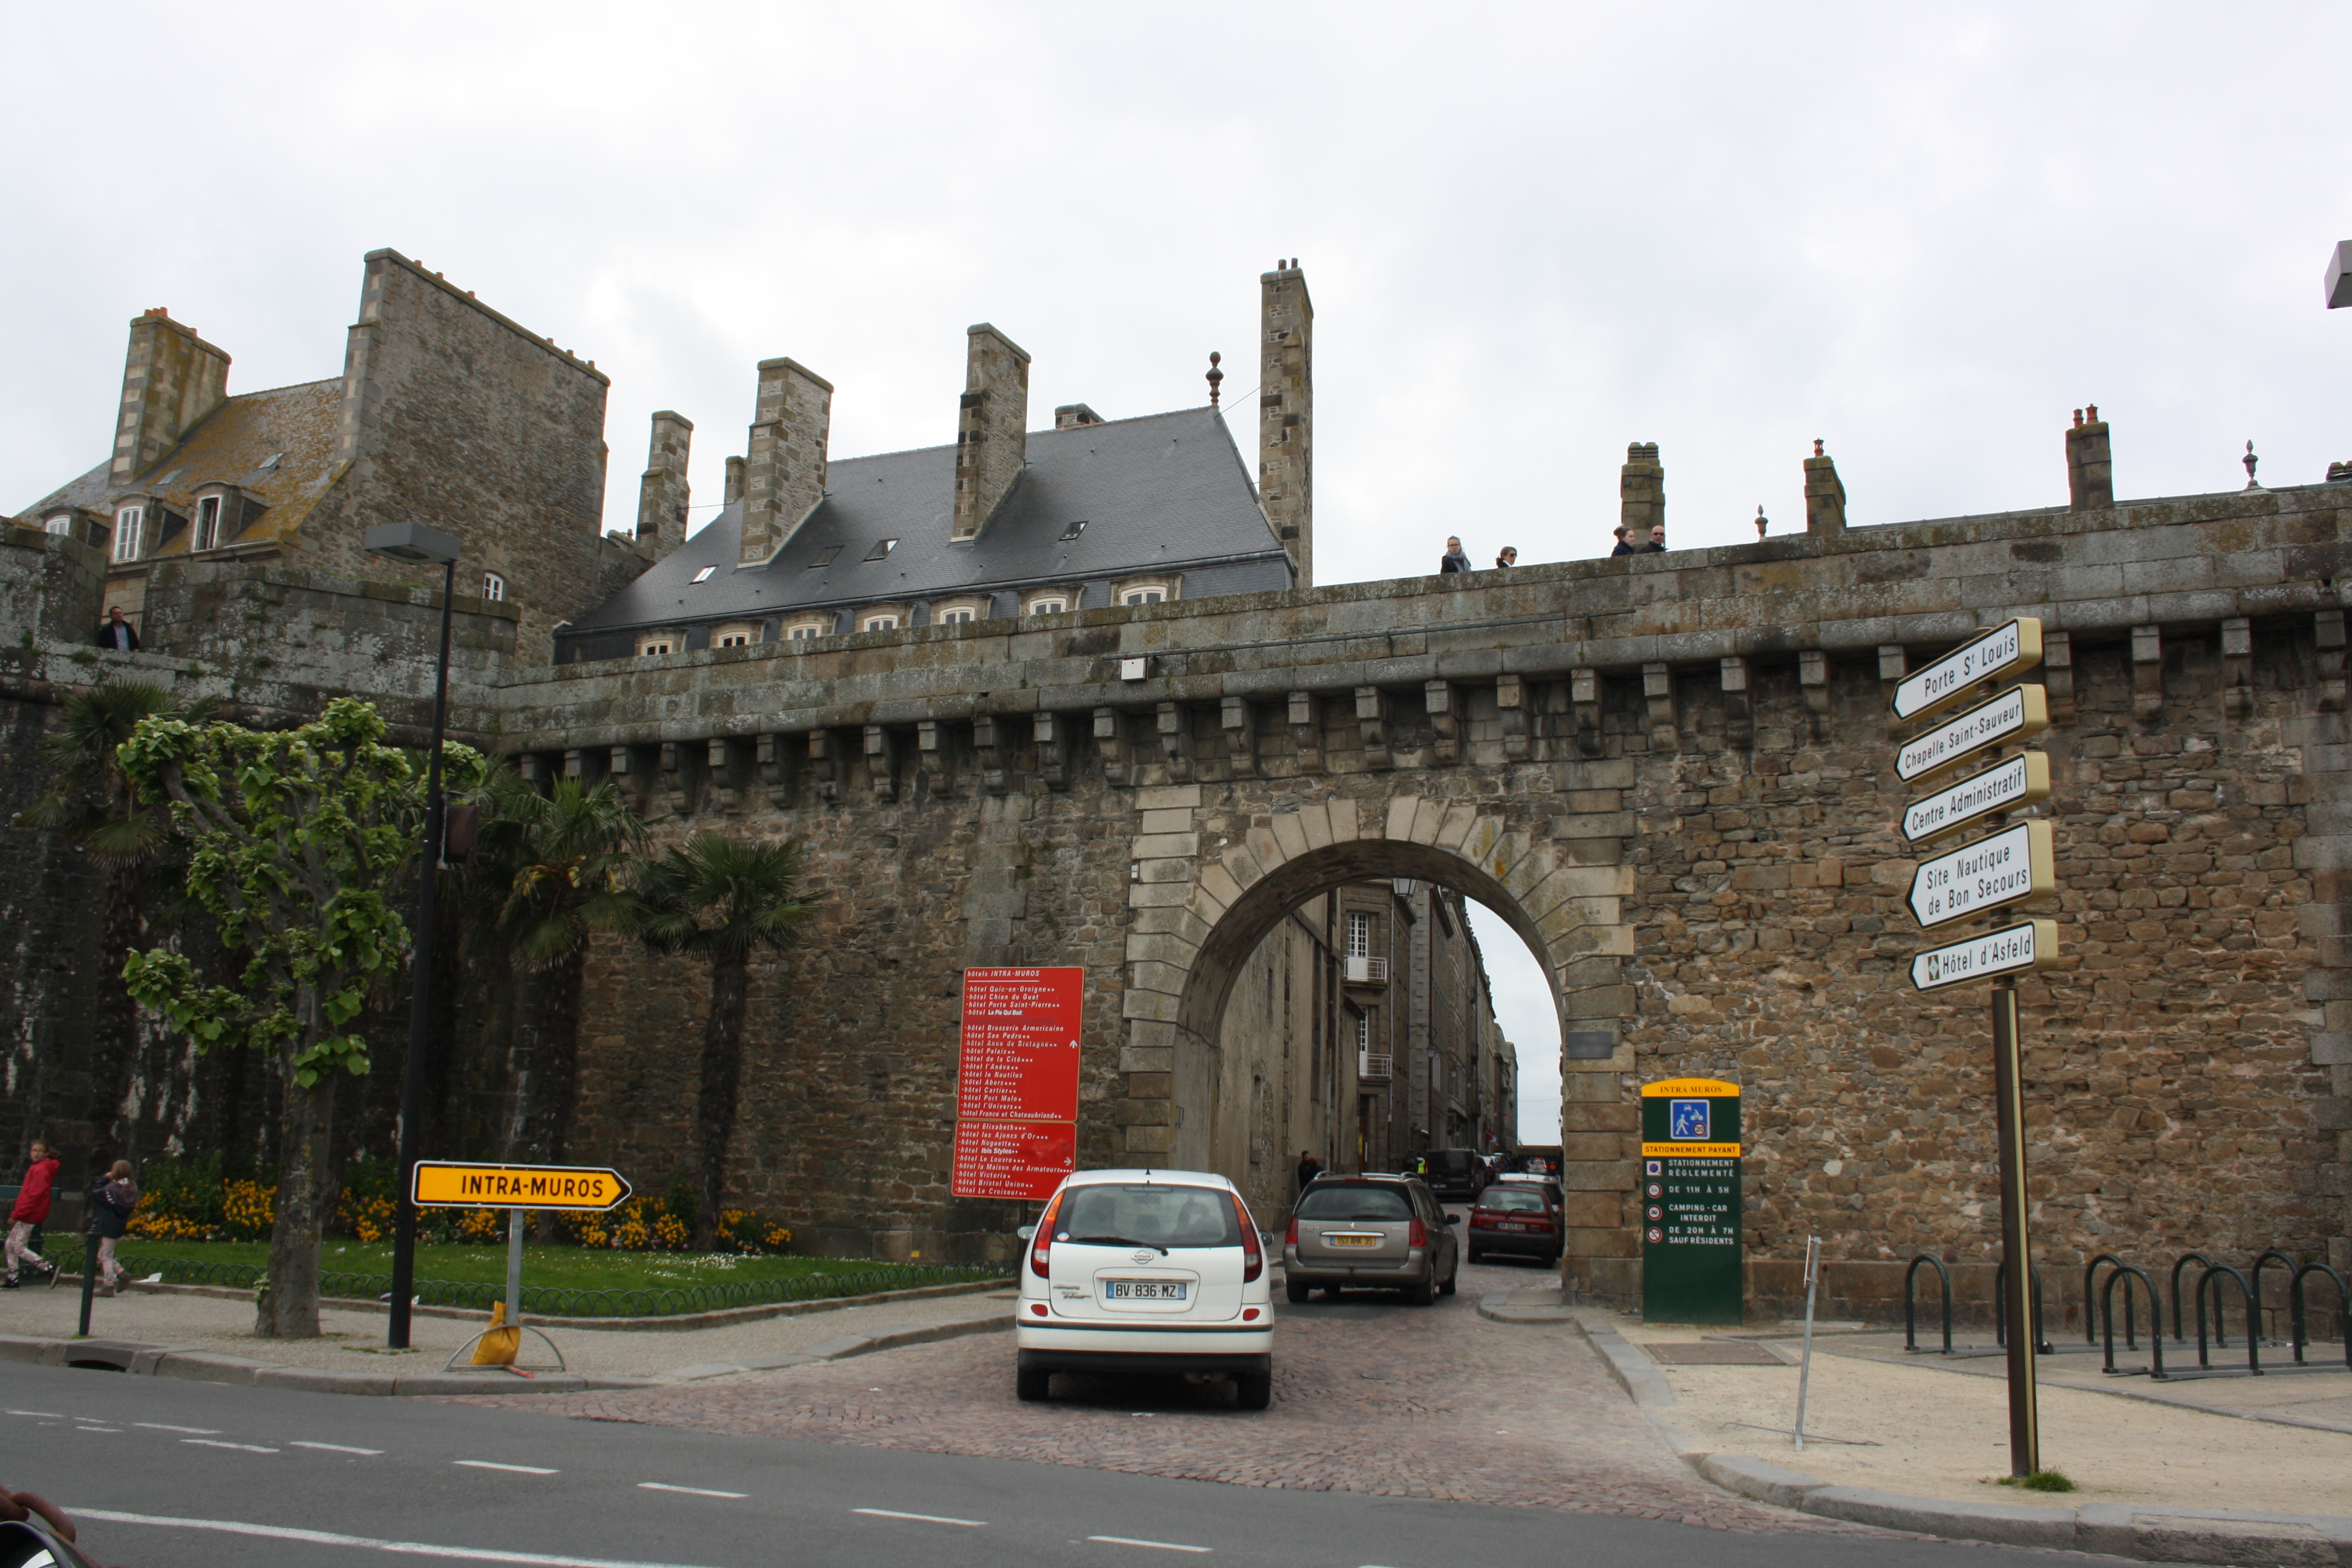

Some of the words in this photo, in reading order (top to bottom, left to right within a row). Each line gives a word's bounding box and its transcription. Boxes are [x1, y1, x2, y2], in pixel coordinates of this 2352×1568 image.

[1924, 670, 1955, 697] Porte
[1981, 636, 2015, 667] Louis
[1906, 740, 1944, 769] Chapelle
[1949, 703, 2020, 749] Saint-Sauveur
[1912, 803, 1944, 831] Centre
[1950, 769, 2022, 816] Administratif
[1927, 866, 1949, 889] Site
[1957, 846, 2010, 881] Nautique
[1929, 895, 1941, 916] de
[1949, 883, 1969, 909] Bon
[1978, 866, 2027, 898] Secours
[1942, 947, 1972, 976] Hôtel
[1981, 934, 2031, 966] d'Asfeld
[462, 1175, 603, 1198] INTRA-MUROS
[1707, 1184, 1712, 1193] À
[1691, 1236, 1734, 1244] RÉSIDENTS
[1711, 1225, 1716, 1234] À
